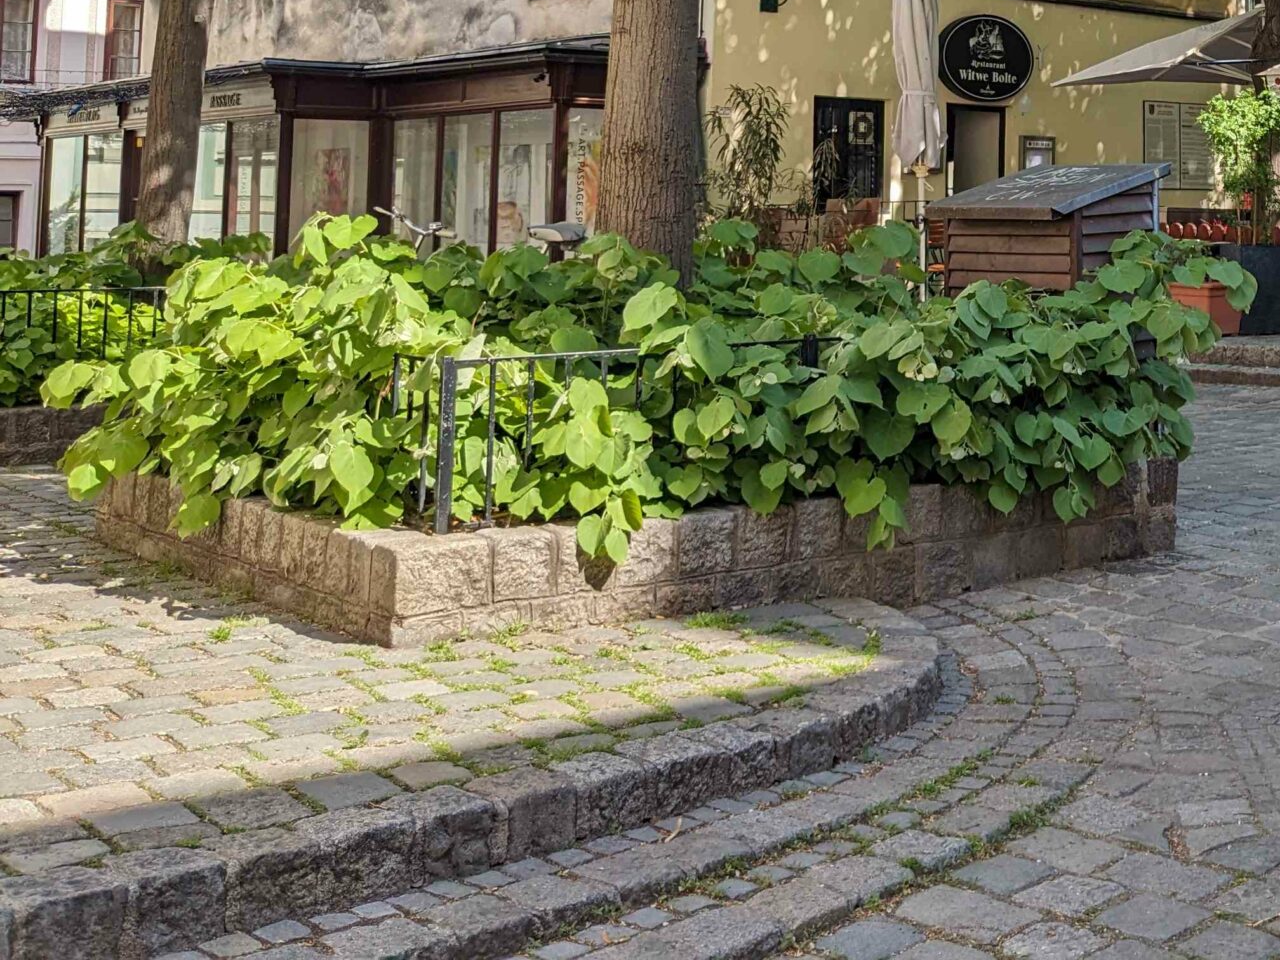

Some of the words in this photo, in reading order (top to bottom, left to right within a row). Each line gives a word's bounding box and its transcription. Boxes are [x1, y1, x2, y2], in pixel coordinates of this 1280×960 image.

[971, 59, 1006, 70] Restaurant
[959, 68, 989, 82] Witwe
[992, 71, 1017, 84] Bolte
